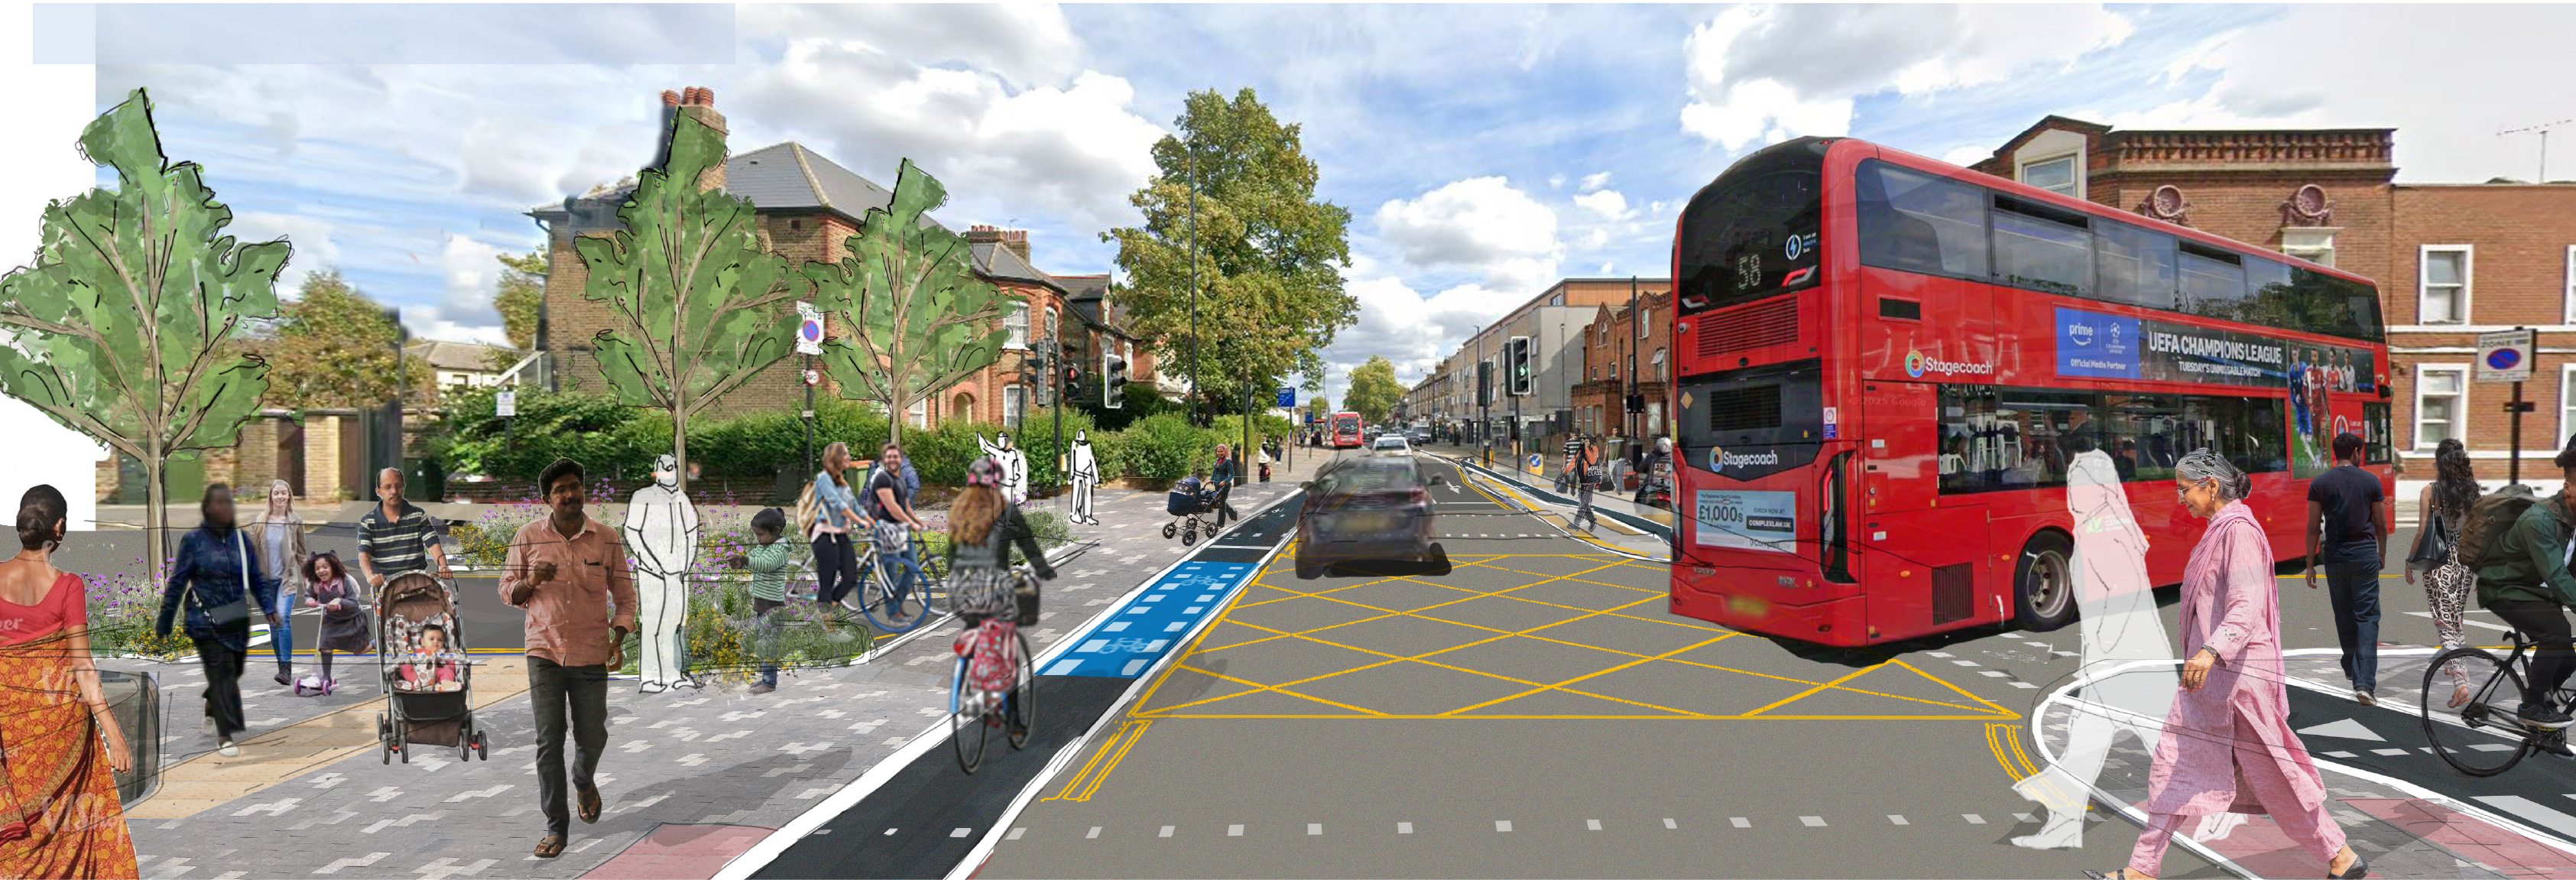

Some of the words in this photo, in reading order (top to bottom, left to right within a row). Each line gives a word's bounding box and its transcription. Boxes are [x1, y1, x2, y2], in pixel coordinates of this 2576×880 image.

[1737, 253, 1762, 290] 58
[2068, 322, 2094, 337] prime
[2148, 331, 2180, 354] UEFA
[2180, 335, 2244, 360] CHAMPIONS
[2245, 343, 2282, 365] LEAGUE
[1925, 356, 1993, 377] Stagecoach
[2070, 358, 2091, 368] Official
[2091, 359, 2107, 369] Media
[2107, 361, 2127, 371] Partner
[2179, 361, 2210, 373] TUESDAY'S
[2243, 367, 2261, 378] MATCH
[1723, 449, 1778, 469] Stagecoach
